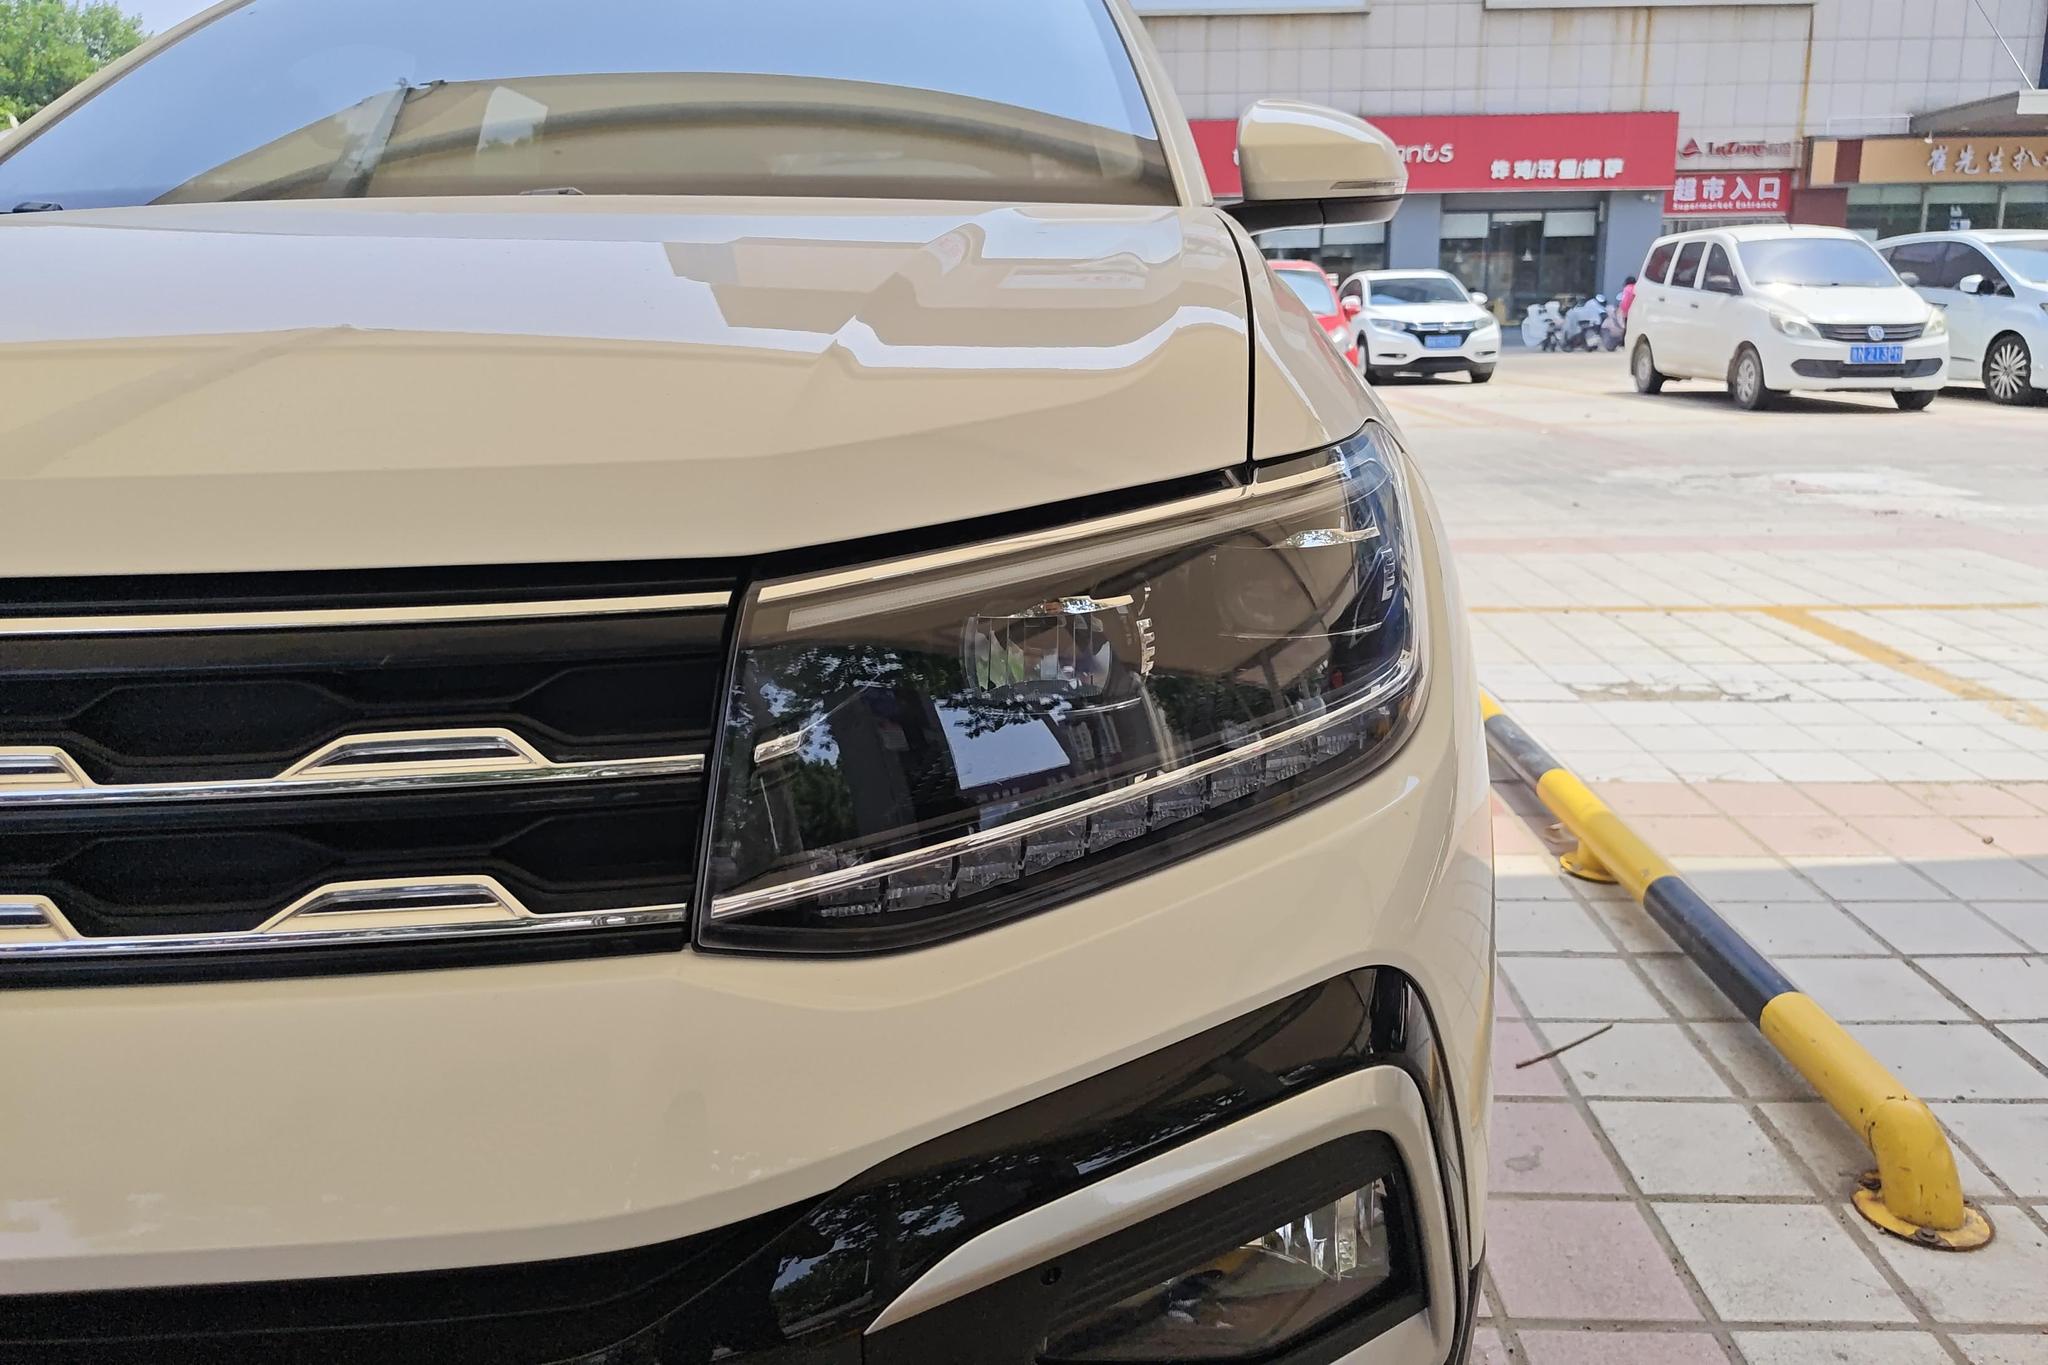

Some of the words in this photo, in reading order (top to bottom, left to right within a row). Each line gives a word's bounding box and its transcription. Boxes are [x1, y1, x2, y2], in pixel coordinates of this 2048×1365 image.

[1926, 144, 2048, 175] 崔先生扒
[1673, 176, 1781, 201] 超市入口
[1673, 201, 1734, 211] Supermarket
[1736, 200, 1778, 209] Entrance
